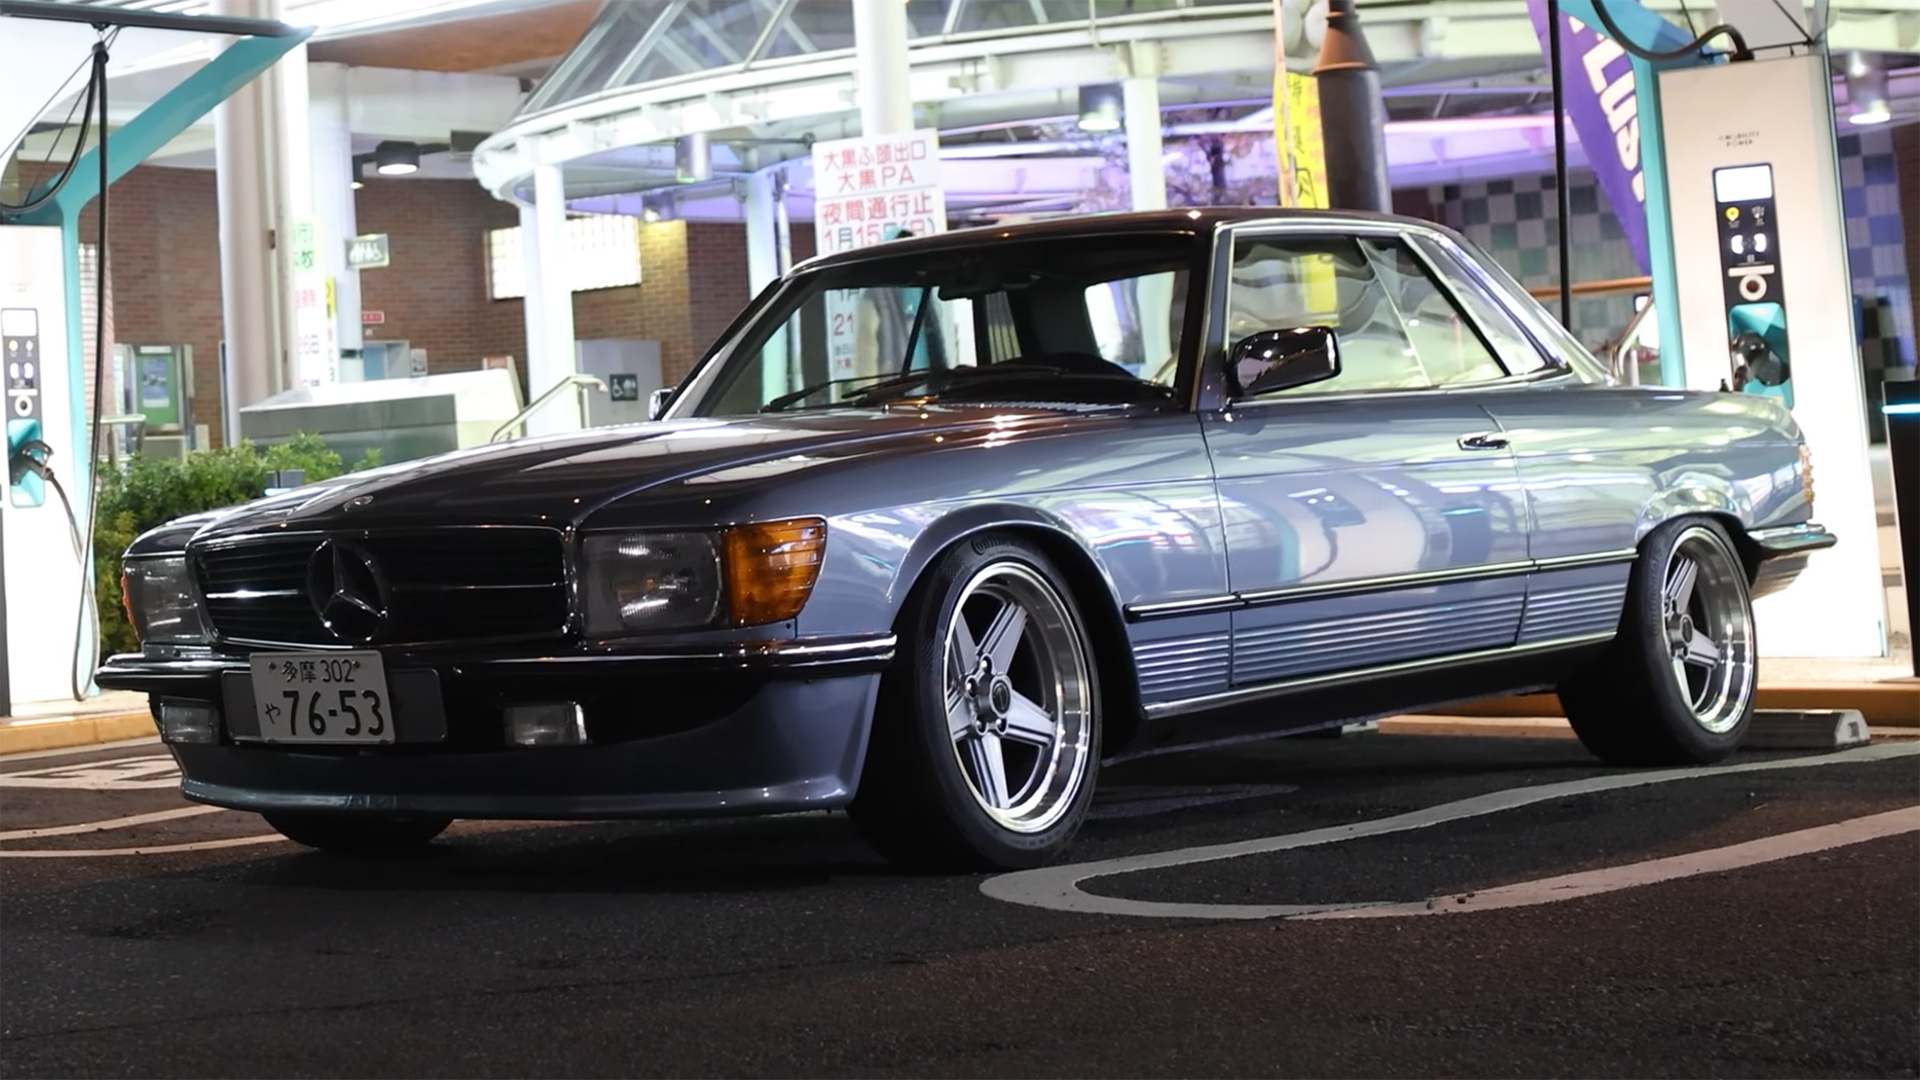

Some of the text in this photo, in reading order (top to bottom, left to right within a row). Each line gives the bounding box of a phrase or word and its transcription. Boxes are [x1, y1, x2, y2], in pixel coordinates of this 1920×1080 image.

[824, 140, 926, 172] 大黒ふ頭出口
[823, 192, 933, 225] 夜間通行止
[282, 659, 355, 683] 多摩 302
[265, 690, 384, 736] や 76-53
